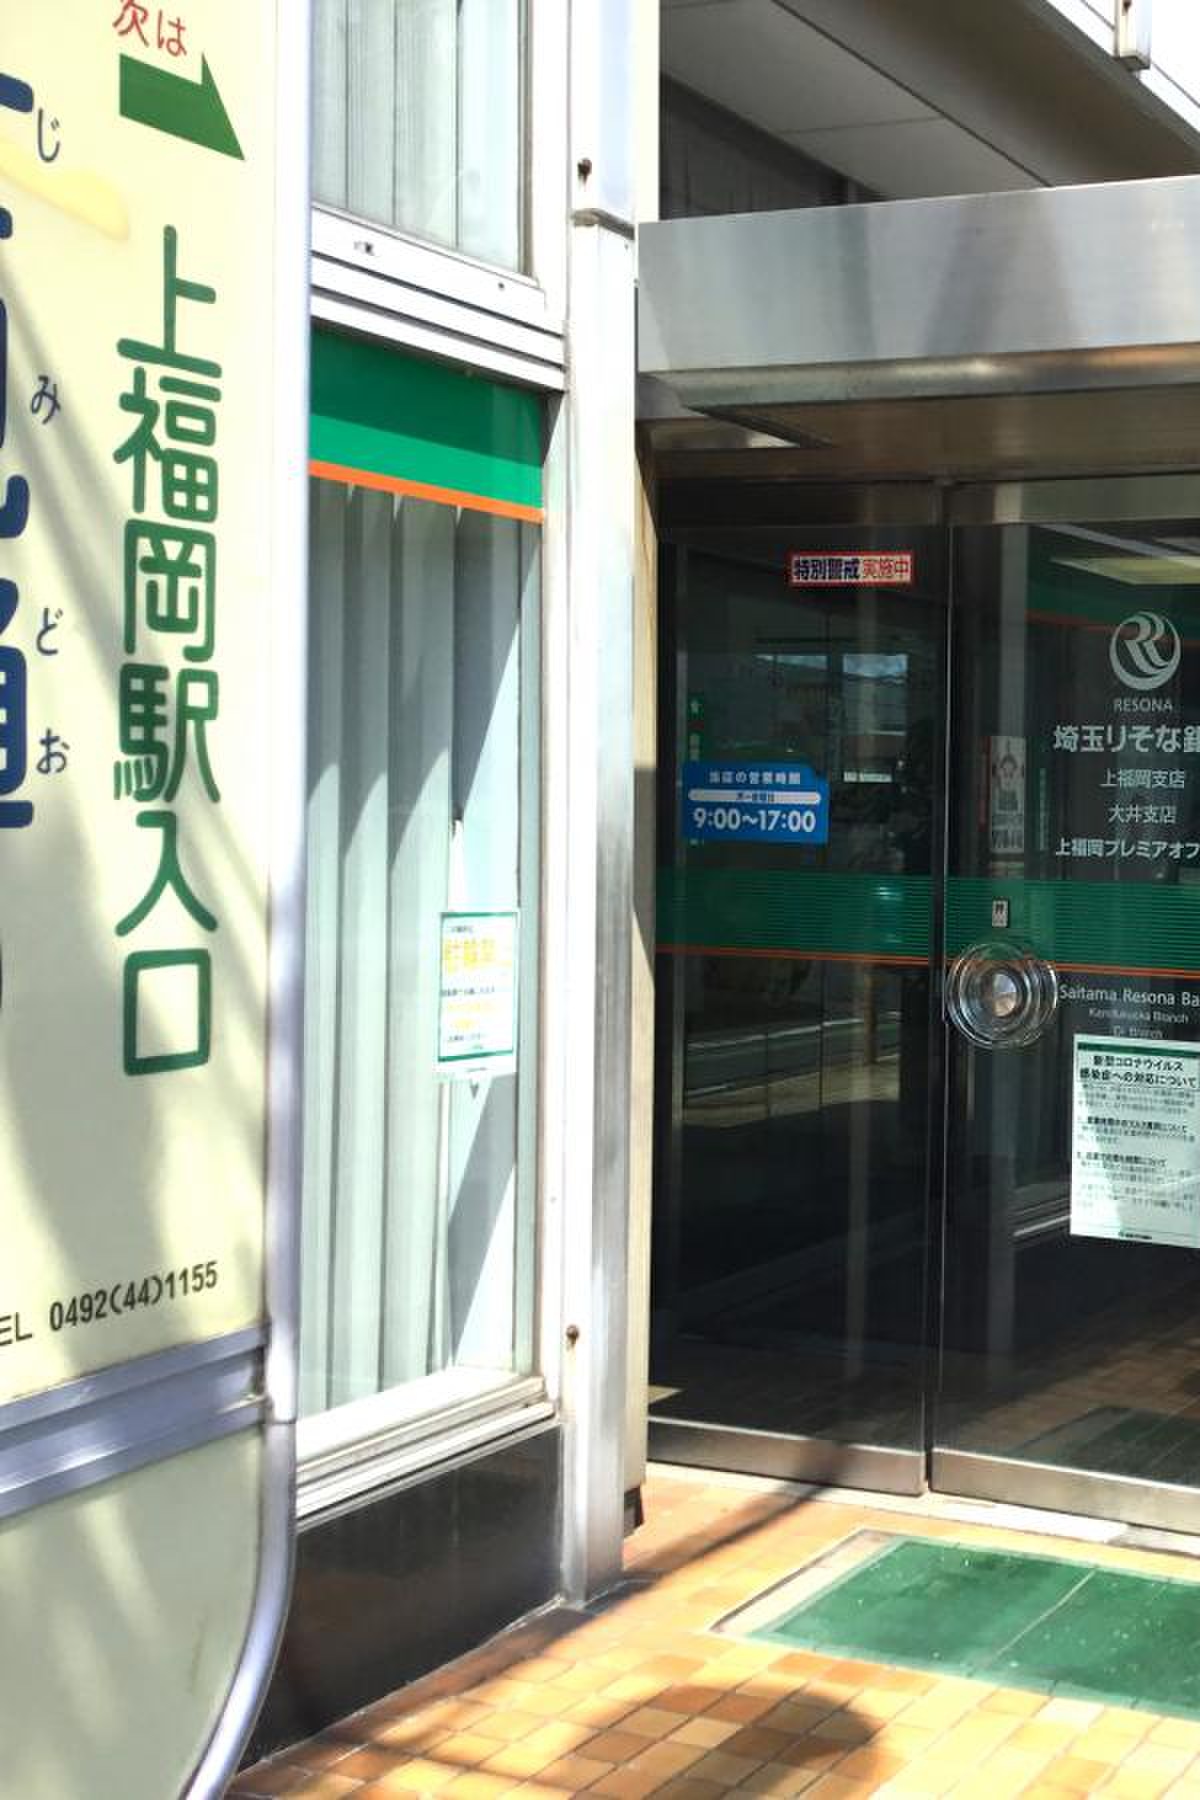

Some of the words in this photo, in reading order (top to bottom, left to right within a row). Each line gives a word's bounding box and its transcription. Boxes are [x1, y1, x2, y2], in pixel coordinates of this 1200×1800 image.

[112, 0, 187, 56] 次は
[113, 224, 222, 1076] 上福岡駅入口
[1114, 698, 1173, 713] RESONA
[1099, 768, 1185, 789] 上福岡支店
[1107, 804, 1177, 824] 大井支店
[1059, 984, 1118, 1001] Saitama
[1122, 988, 1176, 1006] Resona
[0, 1312, 33, 1347] EL
[49, 1260, 218, 1331] 0492(44)1155
